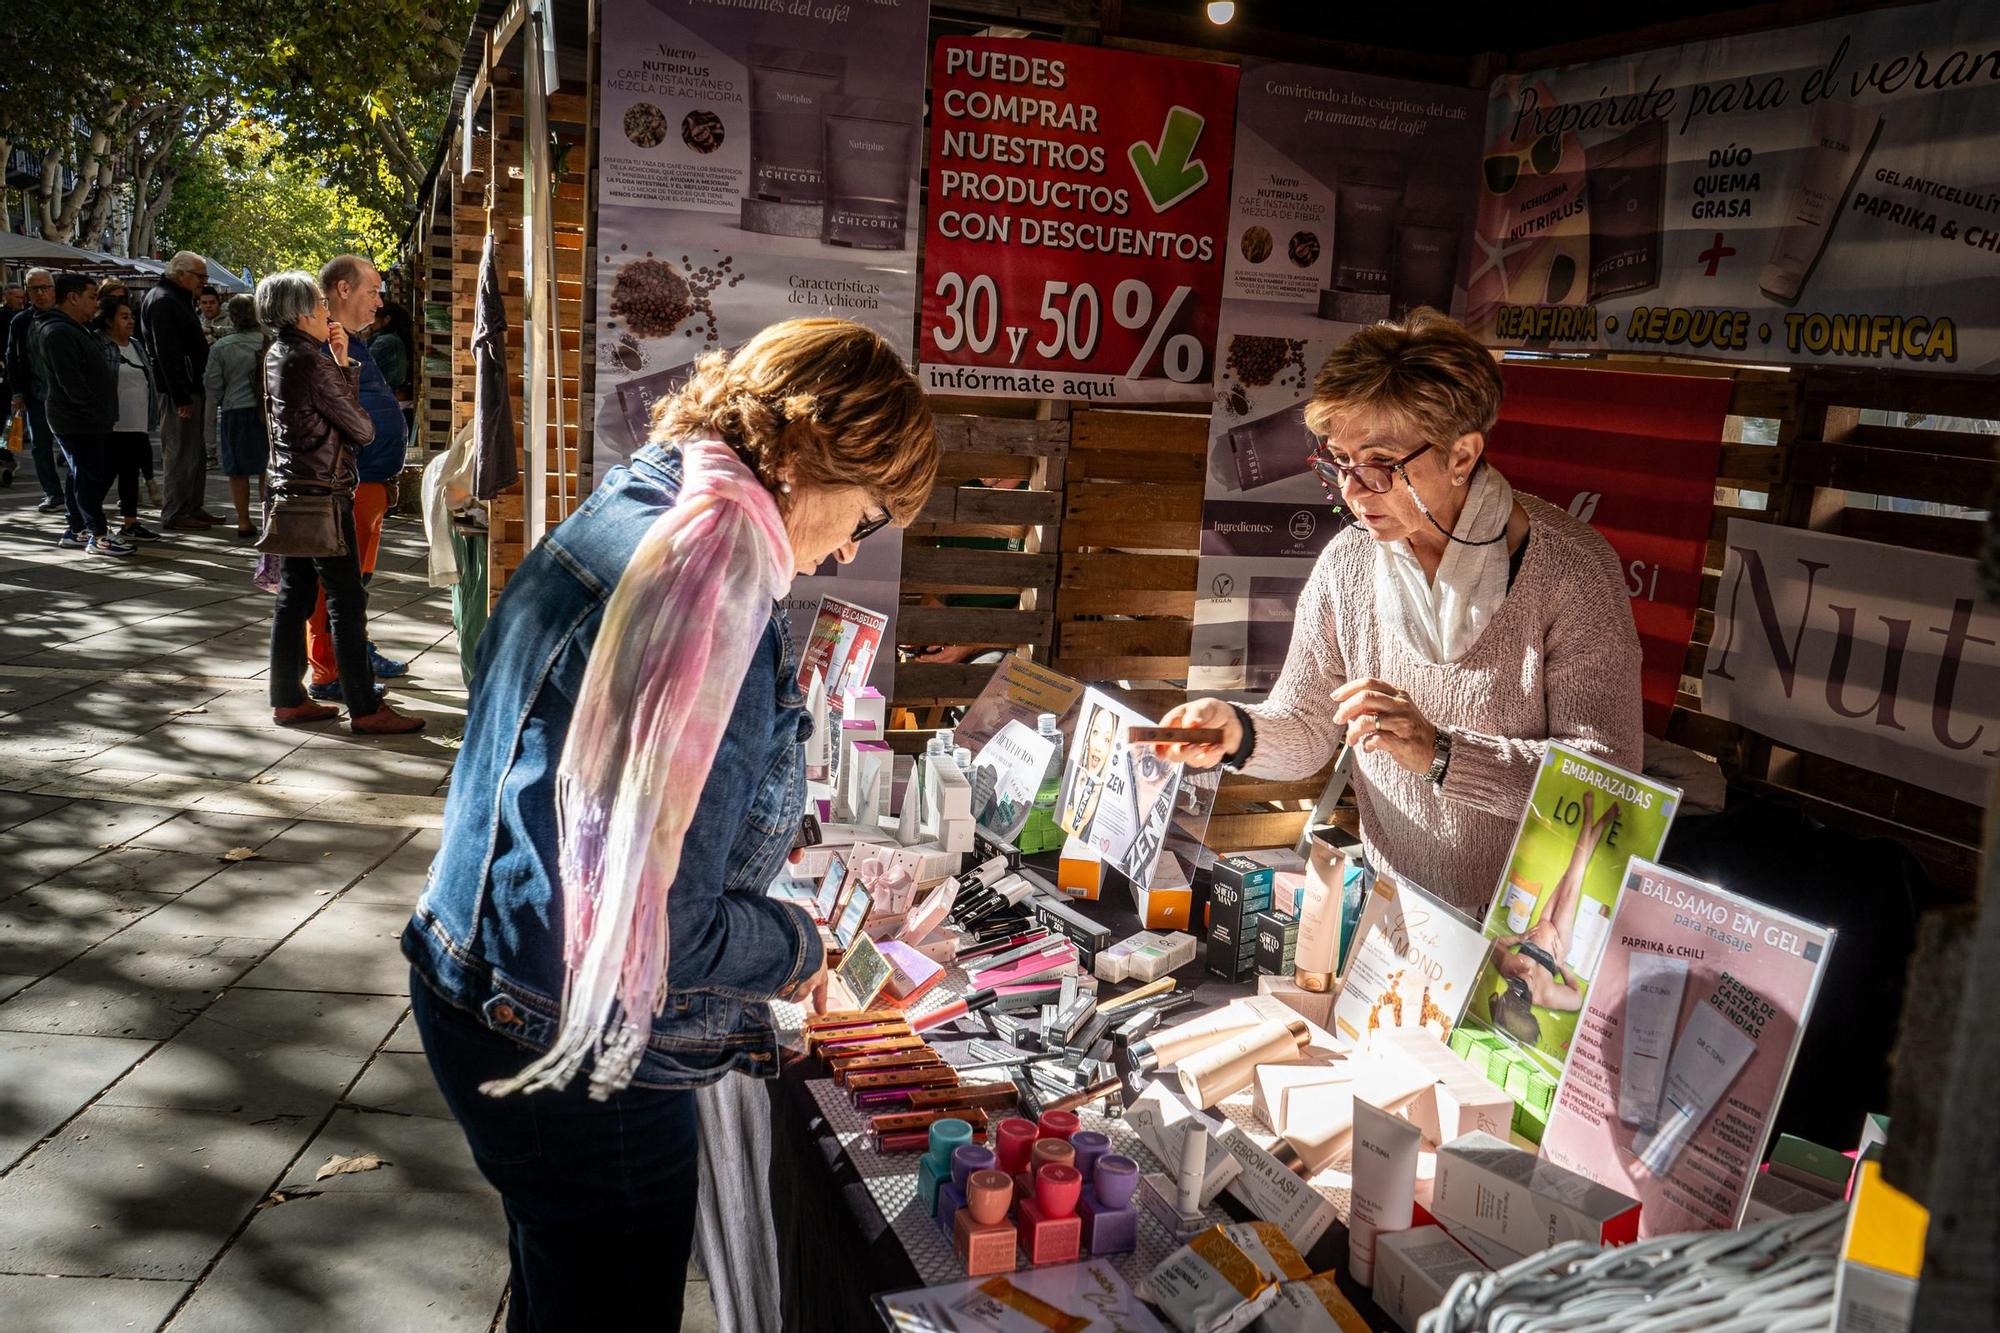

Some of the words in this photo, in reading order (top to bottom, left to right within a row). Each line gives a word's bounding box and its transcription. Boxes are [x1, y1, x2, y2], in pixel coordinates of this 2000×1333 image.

[788, 1, 811, 18] del
[656, 42, 697, 60] Nuevo
[642, 60, 710, 78] NUTRIPLUS
[946, 46, 1066, 88] PUEDES
[607, 79, 656, 94] MEZCLA
[659, 85, 677, 97] DE
[678, 88, 744, 104] ACHICORIA
[1265, 80, 1340, 103] Convirtiendo
[1341, 95, 1349, 105] a
[1351, 92, 1366, 107] los
[1368, 96, 1425, 115] escépticos
[1426, 102, 1443, 117] del
[1445, 105, 1468, 121] café
[1510, 74, 1677, 150] Prepárate
[1680, 75, 1791, 136] para
[1801, 34, 1850, 106] el
[943, 88, 1098, 133] COMPRAR
[1326, 111, 1377, 129] amantes
[1379, 115, 1397, 132] del
[941, 129, 1106, 173] NUESTROS
[1708, 143, 1752, 168] DÚO
[758, 169, 826, 184] ACHICORI
[1268, 173, 1300, 187] Nuevo
[1693, 172, 1760, 198] QUEMA
[1875, 167, 1900, 187] GEL
[941, 169, 1130, 215] PRODUCTOS
[1257, 188, 1309, 202] NUTRIPLUS
[1519, 182, 1568, 213] ACHICORIA
[1241, 207, 1277, 219] MEZCLA
[1279, 210, 1292, 220] DE
[1294, 212, 1321, 222] FIBRA
[1510, 199, 1585, 241] NUTRIPLUS
[1691, 198, 1752, 219] GRASA
[830, 215, 899, 230] ACHICORIA
[1852, 191, 1937, 235] PAPRIKA
[1940, 219, 1959, 240] &
[1963, 225, 2000, 254] CH
[938, 211, 1010, 242] CON
[1019, 217, 1214, 262] DESCUENTOS
[788, 275, 880, 296] Características
[788, 291, 805, 305] de
[807, 291, 818, 305] la
[820, 295, 879, 310] Achicoria
[932, 271, 998, 354] 30
[1005, 325, 1028, 364] y
[1035, 280, 1099, 361] 50
[1496, 305, 1597, 341] REAFIRMA
[1627, 306, 1750, 349] REDUCE
[1784, 311, 1957, 362] TONIFICA
[929, 367, 1055, 395] infórmate
[1062, 375, 1117, 401] aquí
[1214, 520, 1273, 535] Ingredientes:
[825, 602, 841, 615] PARA
[841, 608, 850, 618] EL
[1106, 772, 1125, 796] ZEN
[1561, 758, 1654, 810] EMBARAZADAS
[1641, 877, 1728, 925] BÁLSAMO
[1732, 912, 1761, 939] EN
[1763, 926, 1800, 956] GEL
[1673, 913, 1701, 932] para
[1705, 924, 1753, 953] masaje
[1621, 936, 1665, 953] PAPRIKA
[1665, 943, 1674, 954] &
[1676, 945, 1705, 961] CHILI
[1718, 985, 1766, 1027] CASTAÑO
[1720, 971, 1759, 1003] PFERDE
[1759, 1002, 1776, 1020] DE
[1588, 1006, 1618, 1026] CELULITIS
[1710, 994, 1726, 1013] DE
[1725, 1005, 1761, 1041] INDIAS
[1583, 1019, 1613, 1040] FLACIDEZ
[1575, 1046, 1596, 1063] DOLOR
[1572, 1059, 1603, 1082] MUSCULAR
[1560, 1098, 1569, 1108] DE
[1562, 1089, 1570, 1099] LA
[1565, 1081, 1596, 1104] PROMUEVE
[1596, 1099, 1605, 1110] LA
[1223, 1133, 1268, 1174] EYEBROW
[1265, 1165, 1273, 1178] &
[1271, 1170, 1299, 1199] LASH
